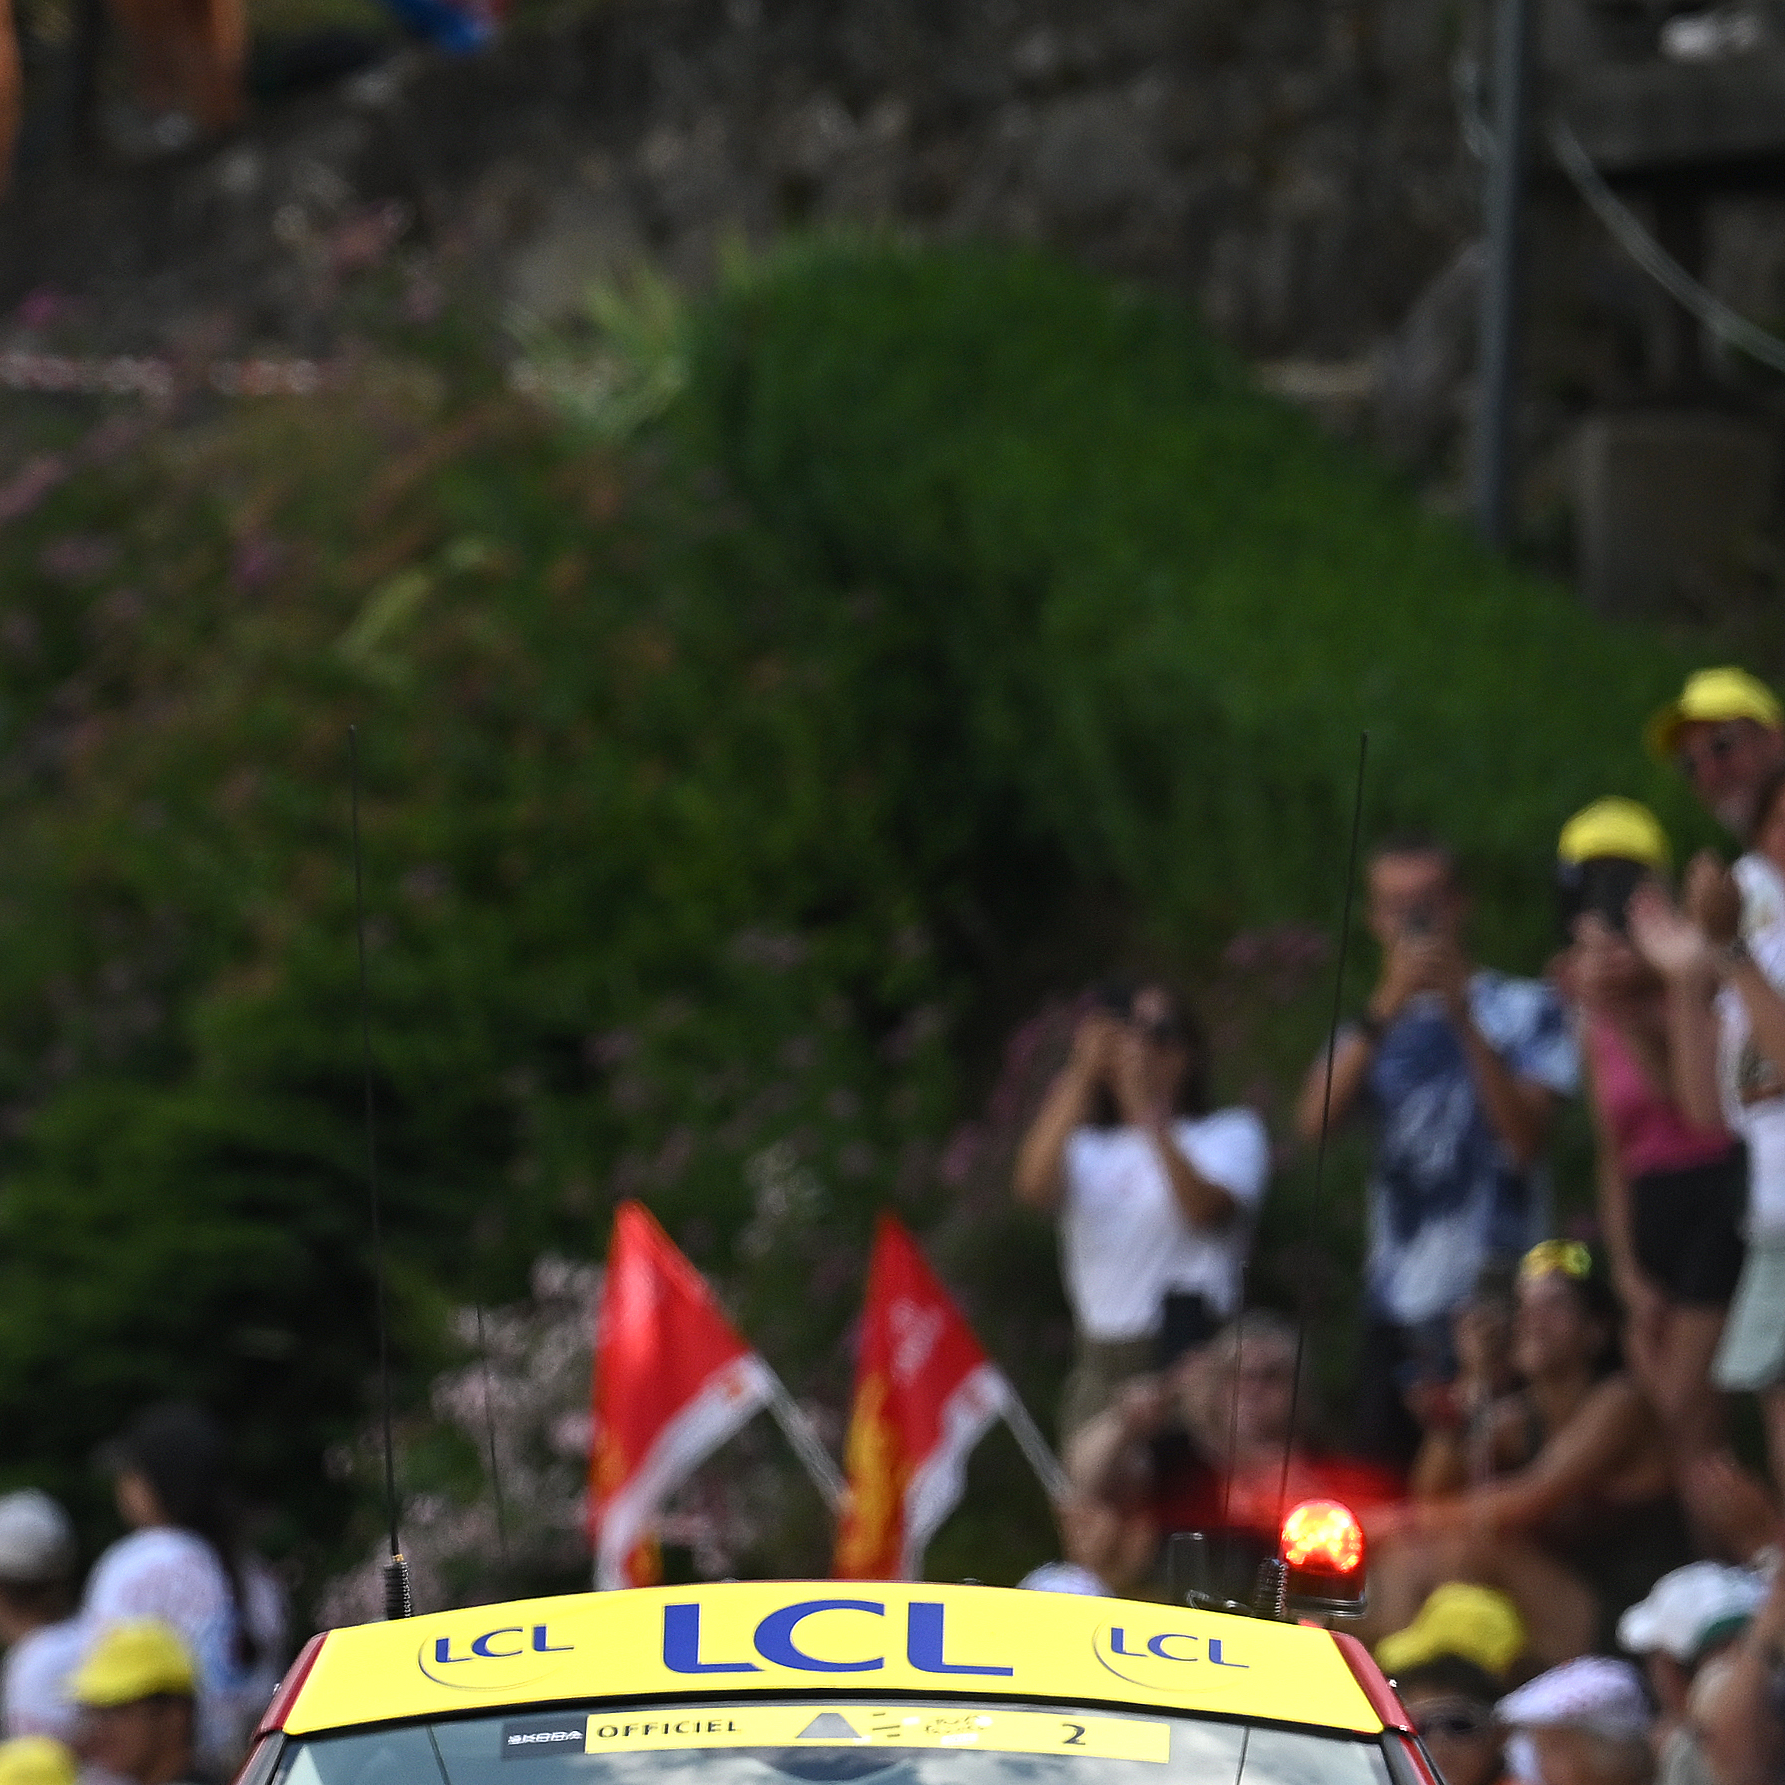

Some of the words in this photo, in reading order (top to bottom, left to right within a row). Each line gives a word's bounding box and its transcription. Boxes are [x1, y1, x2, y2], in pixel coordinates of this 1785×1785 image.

[433, 1624, 574, 1664] LCL
[664, 1601, 1013, 1676] LCL
[1110, 1628, 1249, 1668] LCL
[597, 1718, 738, 1740] OFFICIEL
[1062, 1722, 1087, 1746] 2
